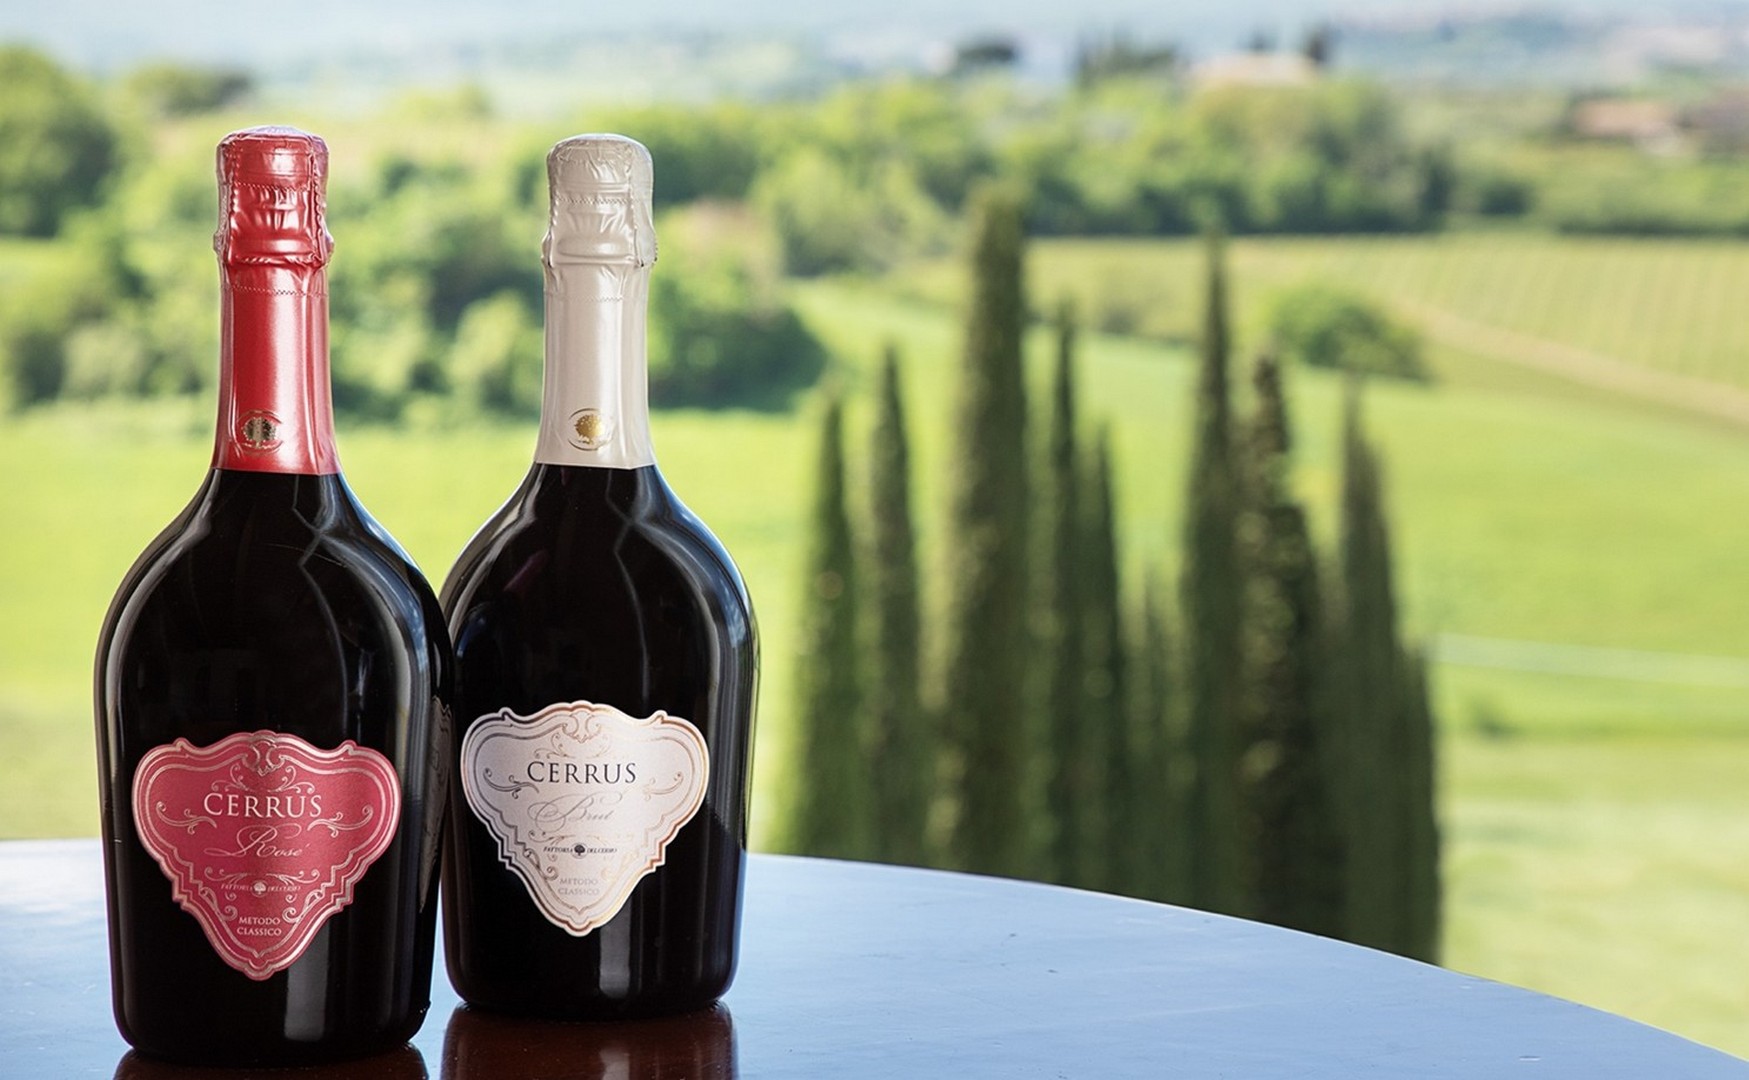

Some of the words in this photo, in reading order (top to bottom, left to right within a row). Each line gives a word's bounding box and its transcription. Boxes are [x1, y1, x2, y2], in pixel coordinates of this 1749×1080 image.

[527, 761, 637, 784] CERRUS
[203, 793, 322, 818] CERRUS
[527, 791, 623, 833] Brut
[559, 878, 599, 886] METODO
[557, 887, 600, 895] CLASSICO
[238, 916, 281, 926] METODO
[236, 926, 282, 936] CLASSICO
